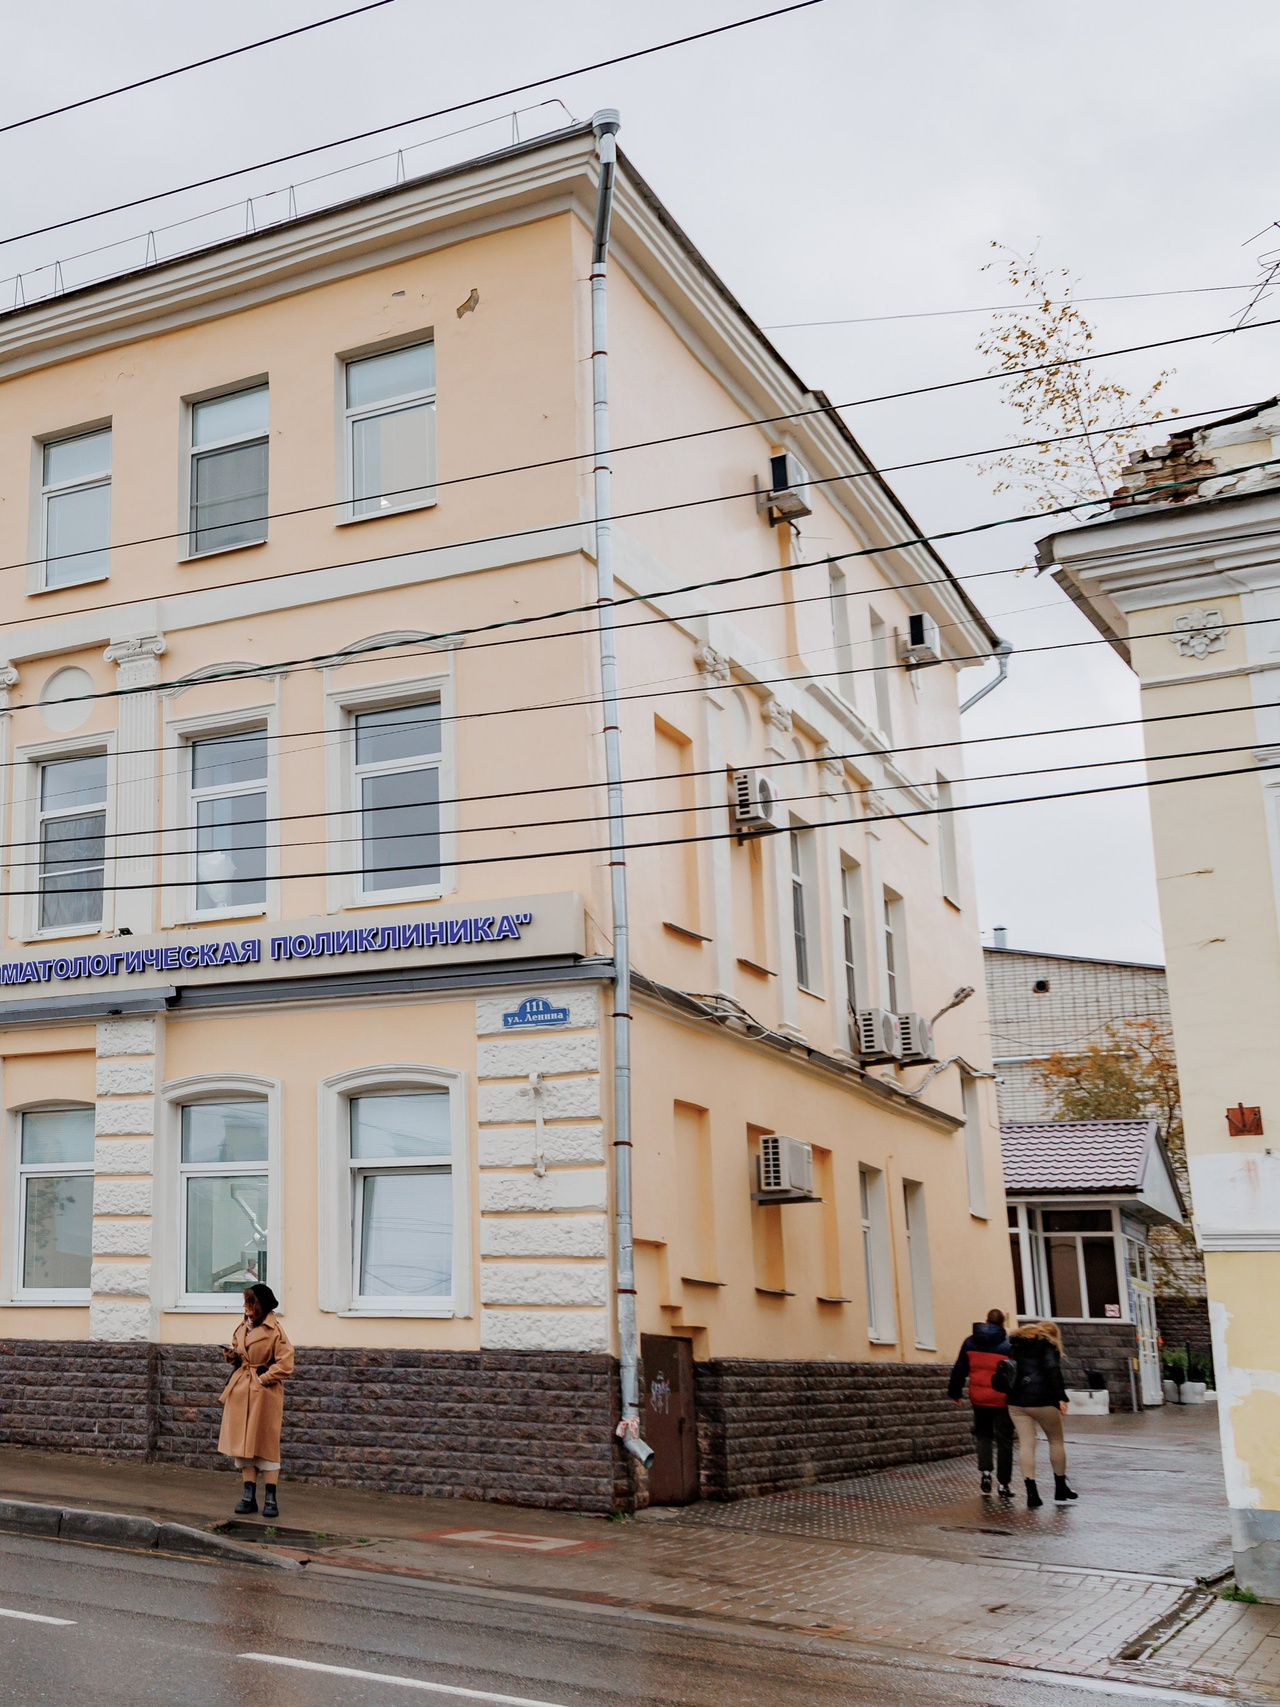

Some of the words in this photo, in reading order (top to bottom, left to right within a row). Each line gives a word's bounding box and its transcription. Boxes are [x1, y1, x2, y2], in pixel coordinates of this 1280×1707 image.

[270, 912, 532, 960] ПОЛИКЛИНИКА"
[525, 1000, 544, 1013] 111
[507, 1015, 522, 1026] ул.
[524, 1012, 564, 1022] Ленина
